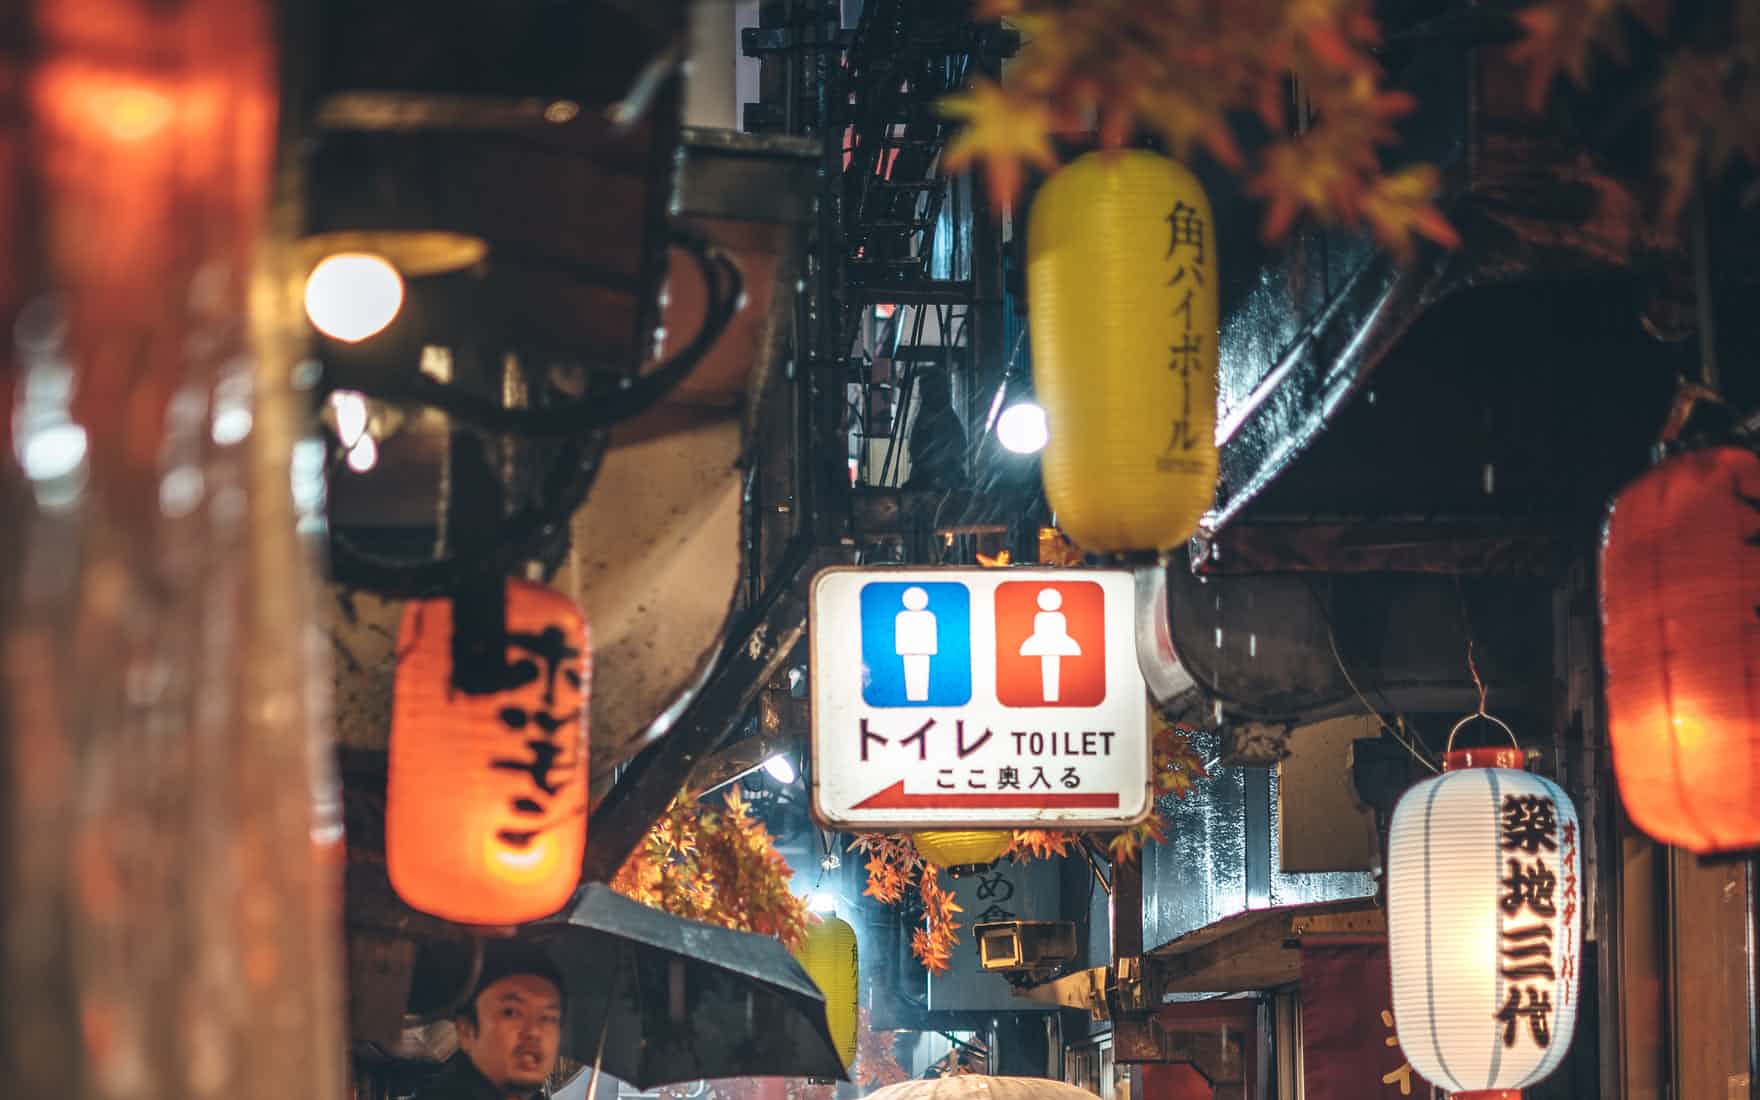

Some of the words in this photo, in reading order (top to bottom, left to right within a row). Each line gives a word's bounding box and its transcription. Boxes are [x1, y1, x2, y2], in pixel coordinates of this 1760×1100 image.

[1163, 200, 1206, 453] 角ハイボール
[858, 717, 993, 762] トイレ
[1010, 731, 1116, 757] TOILET
[936, 765, 1082, 790] ここ奥入る
[1493, 793, 1557, 1049] 築地三代
[1561, 817, 1577, 1006] オイスターバー
